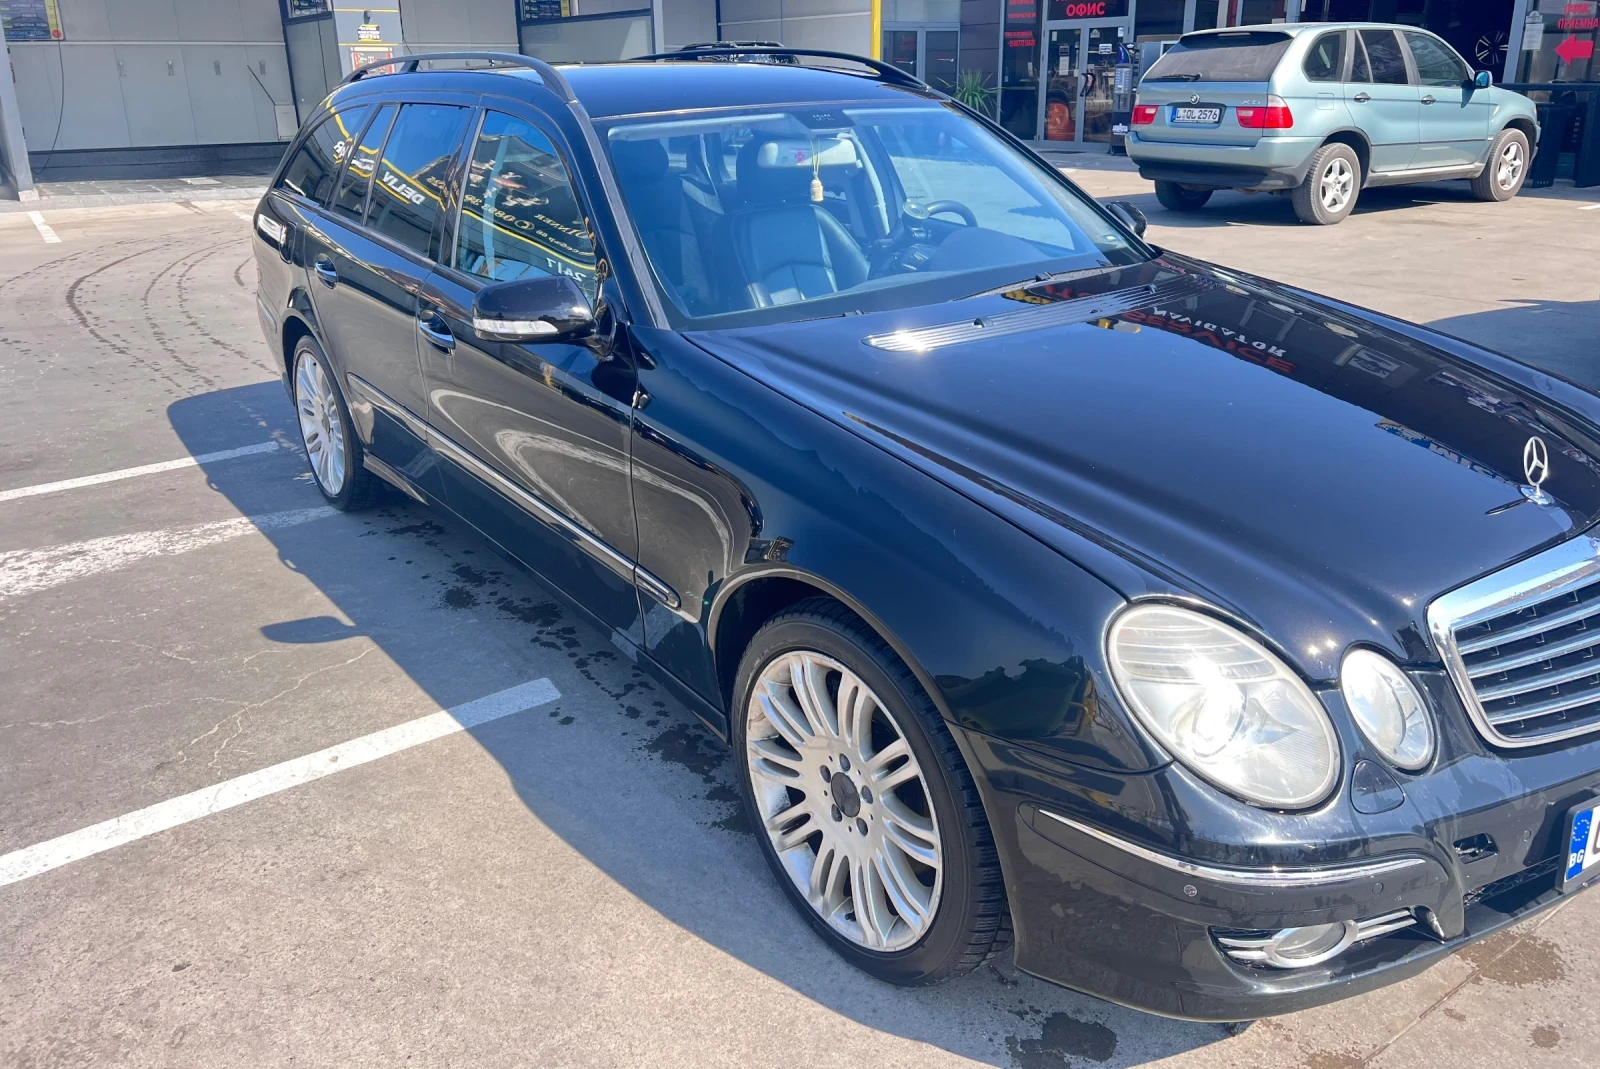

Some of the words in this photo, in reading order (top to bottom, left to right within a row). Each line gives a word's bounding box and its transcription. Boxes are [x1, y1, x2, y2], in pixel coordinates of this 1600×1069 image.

[1066, 2, 1106, 17] ОФИС
[1558, 18, 1599, 29] ПРИЕМНА
[1197, 109, 1218, 120] 2576
[1569, 848, 1584, 869] BG
